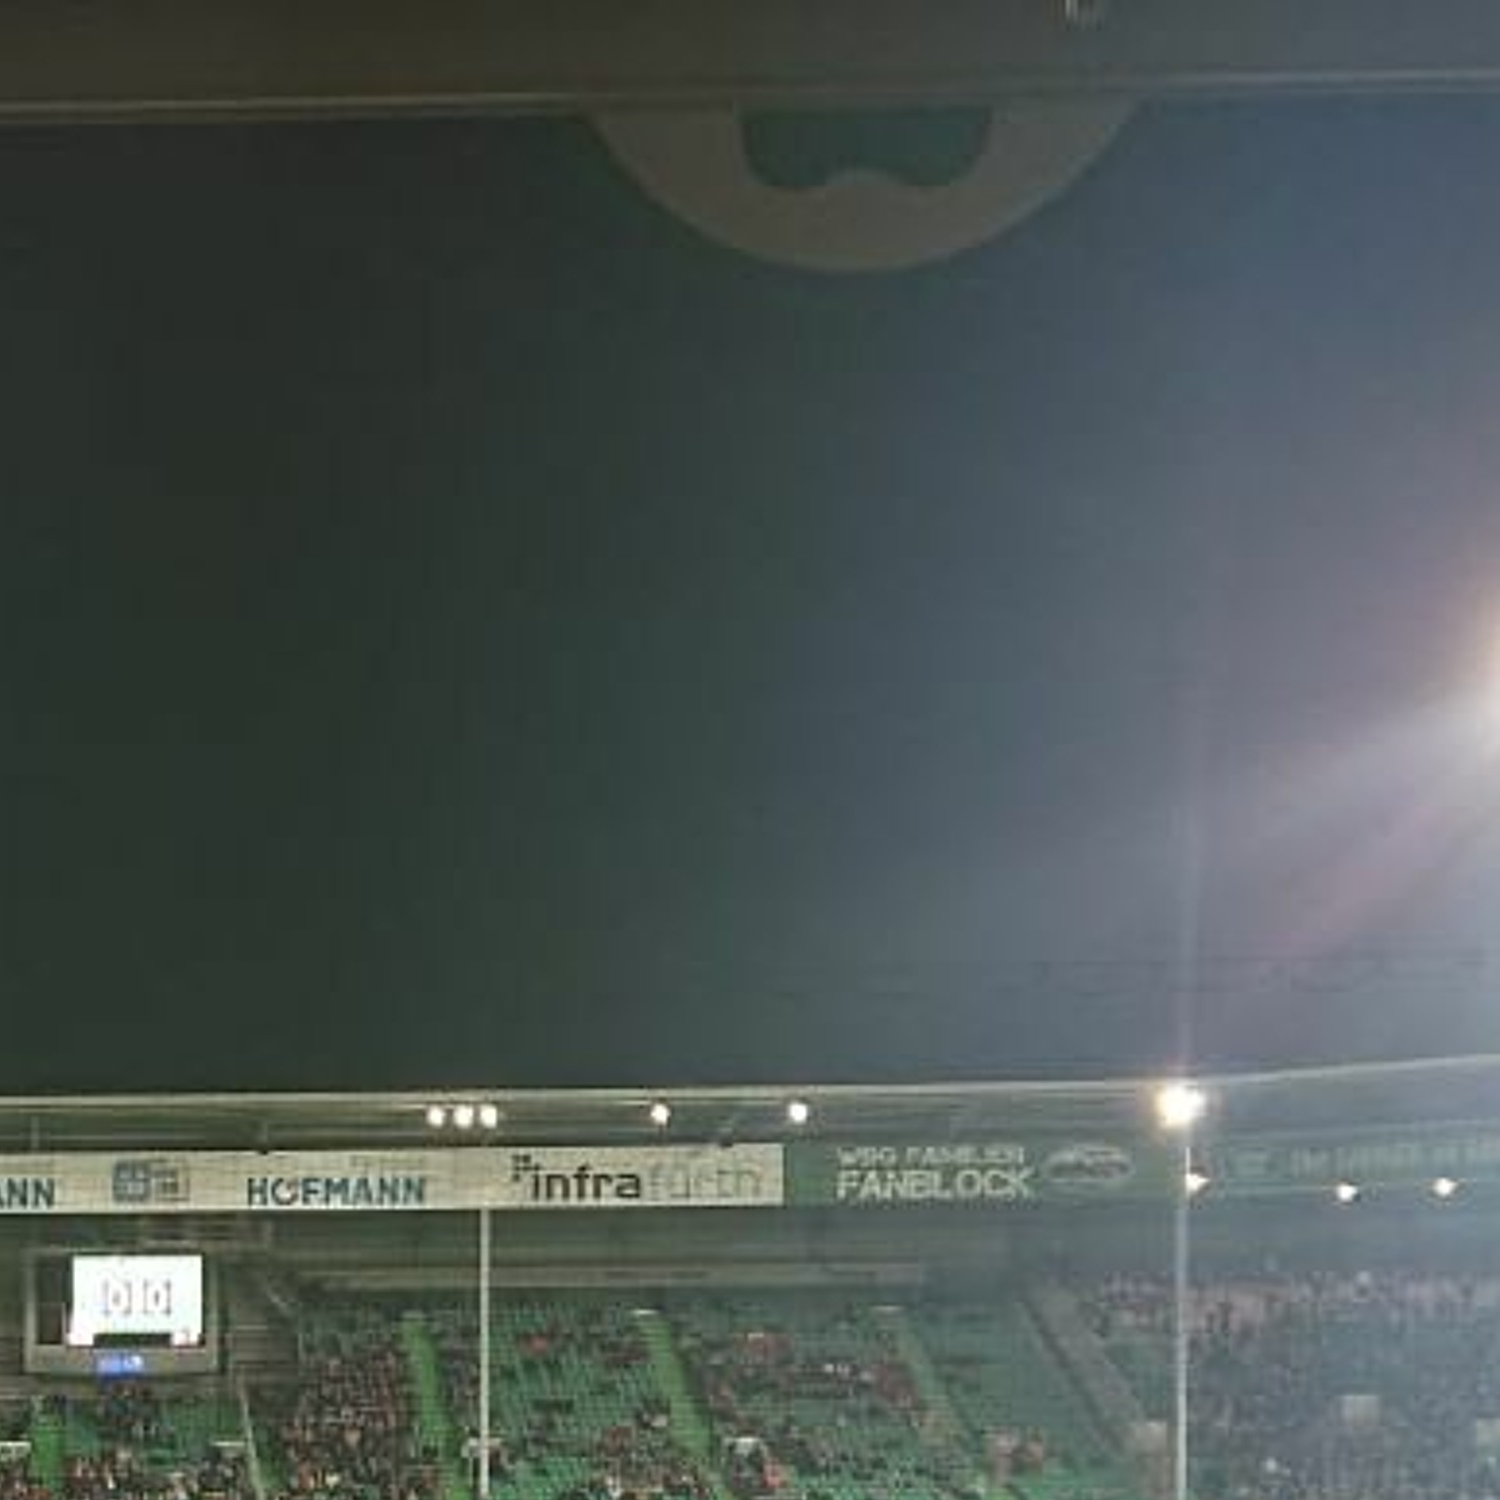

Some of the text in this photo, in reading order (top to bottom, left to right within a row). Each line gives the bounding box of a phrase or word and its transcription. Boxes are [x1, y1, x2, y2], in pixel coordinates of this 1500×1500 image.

[247, 1176, 426, 1206] HOFMANN
[533, 1165, 642, 1199] infra
[835, 1167, 1035, 1201] FANBLOCK
